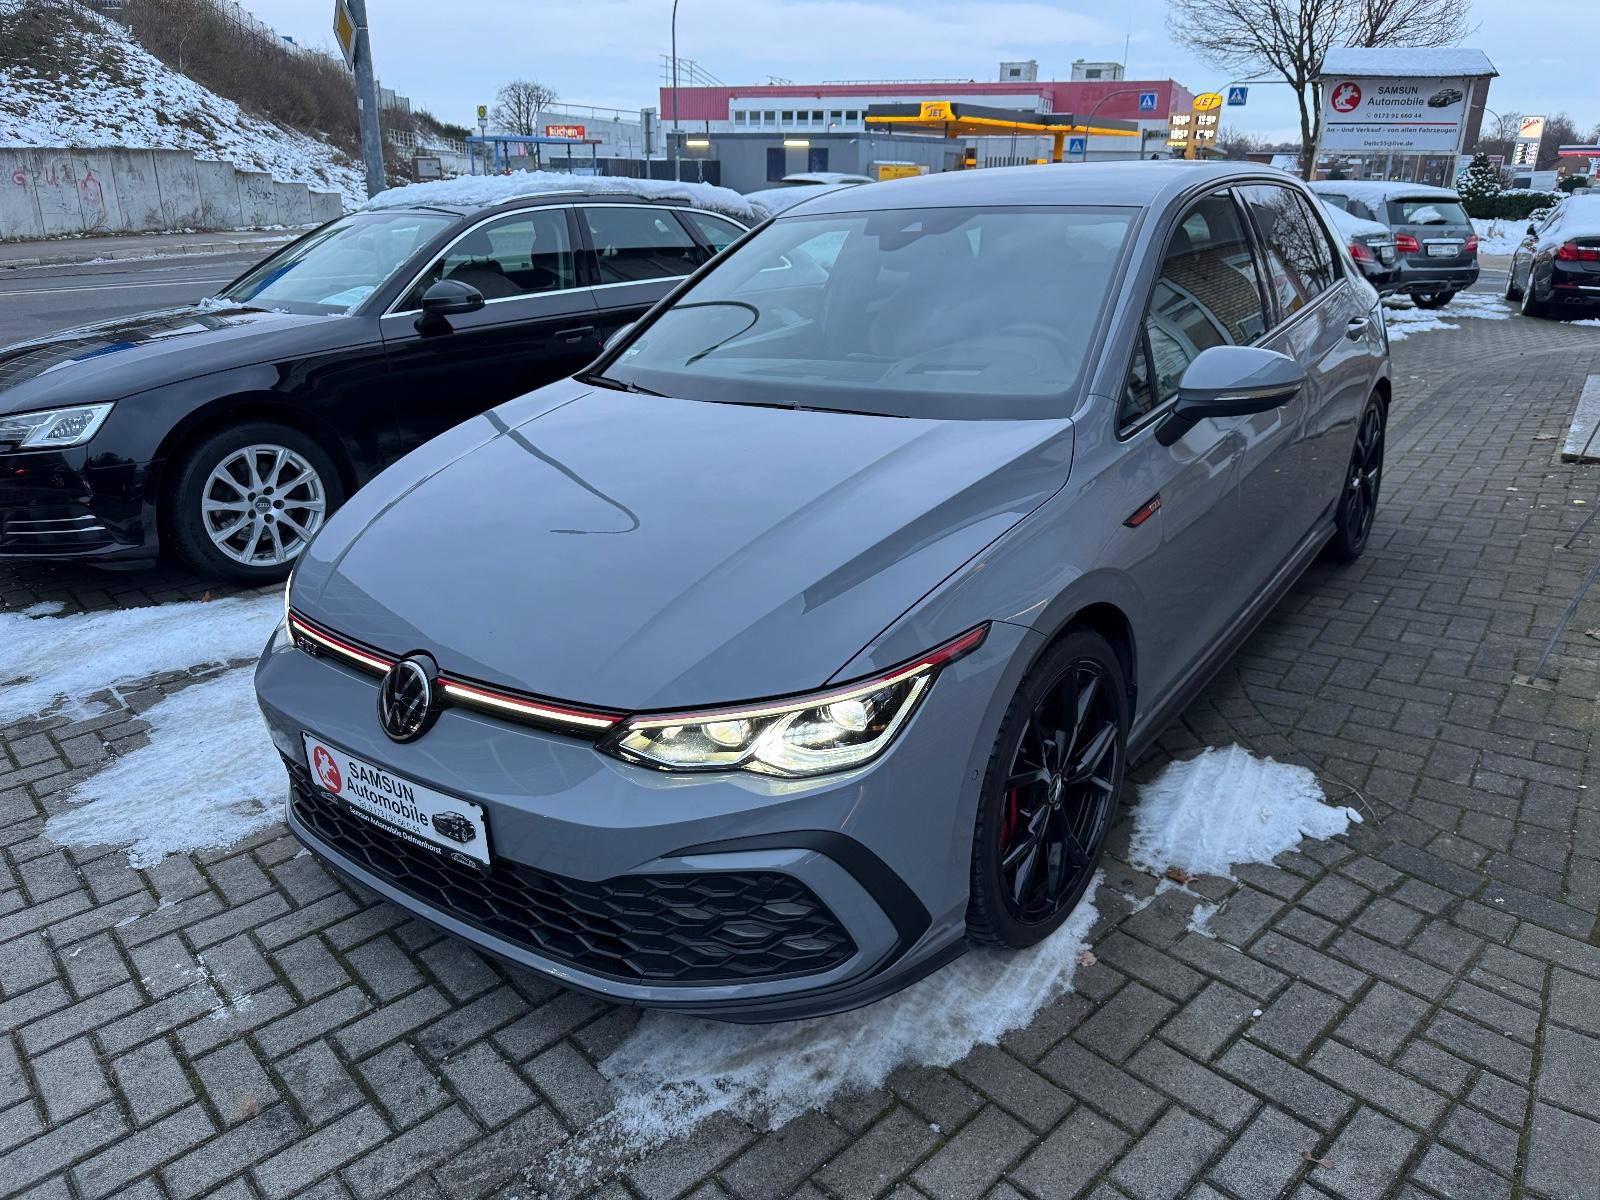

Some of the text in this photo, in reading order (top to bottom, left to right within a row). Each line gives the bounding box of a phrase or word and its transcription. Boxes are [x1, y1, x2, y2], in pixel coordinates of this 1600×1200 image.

[1378, 86, 1418, 95] SAMSUN
[1196, 97, 1219, 106] JET
[1367, 97, 1424, 106] Automobile
[927, 108, 944, 118] JET
[549, 126, 577, 137] küchen
[349, 762, 415, 804] SAMSUN
[347, 777, 429, 826] Automobile
[402, 832, 442, 855] Delmenhorst
